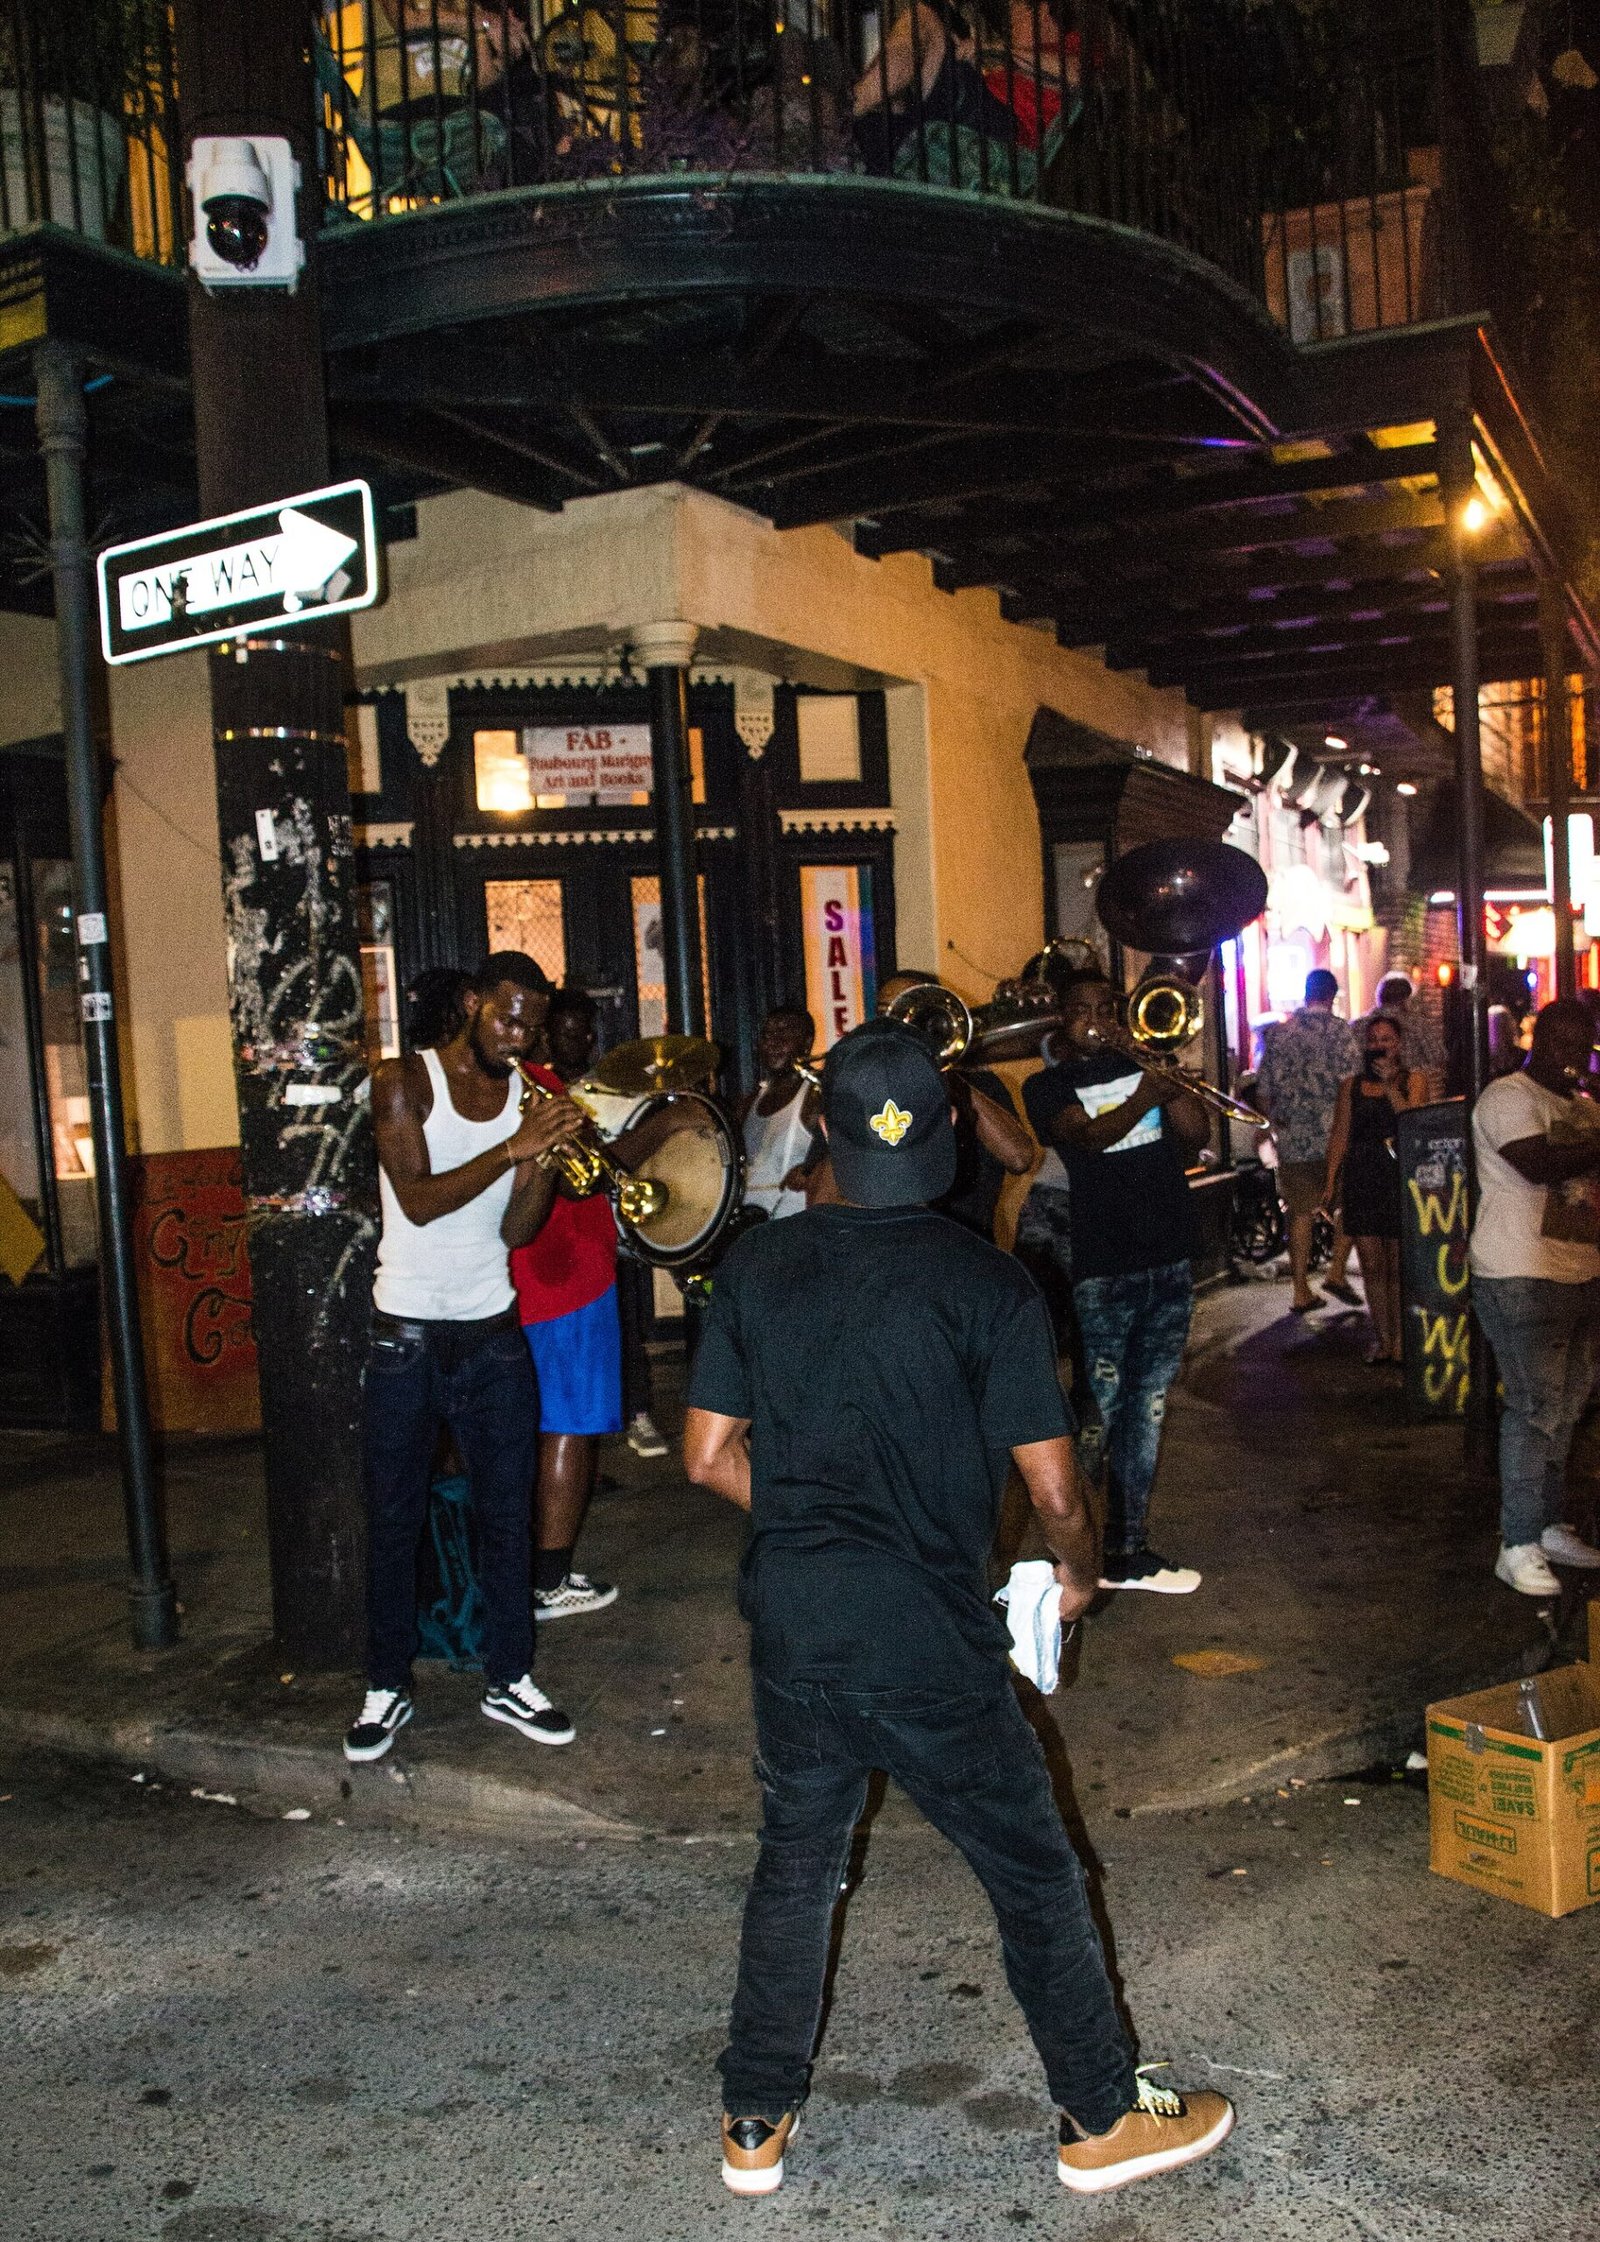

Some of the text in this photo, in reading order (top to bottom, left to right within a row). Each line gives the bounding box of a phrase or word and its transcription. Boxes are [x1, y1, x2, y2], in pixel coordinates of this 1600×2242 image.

[131, 543, 279, 618] ONE WAY
[566, 730, 612, 751] FAB
[568, 773, 596, 788] and
[823, 900, 849, 1037] SALE
